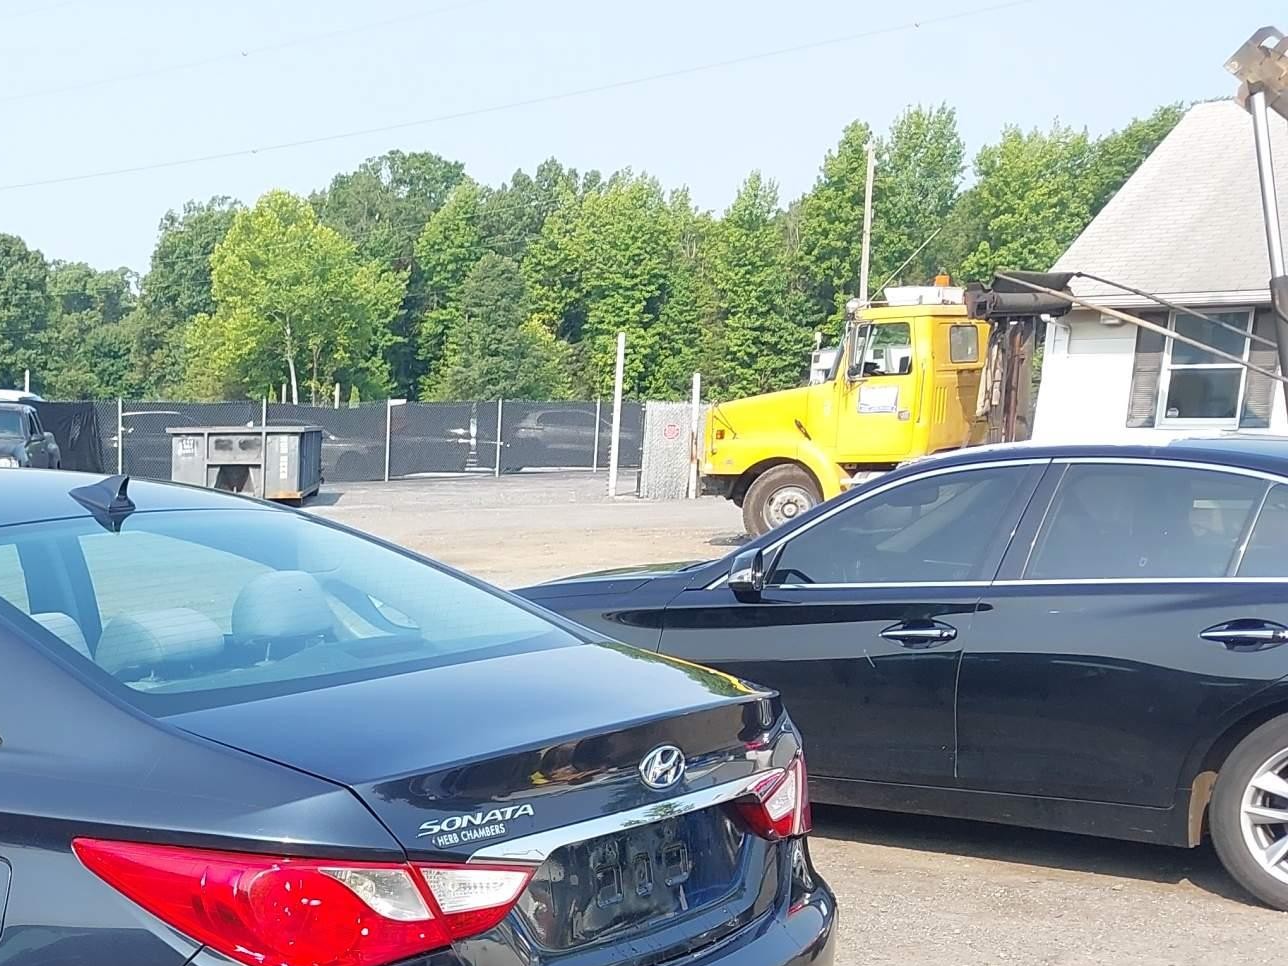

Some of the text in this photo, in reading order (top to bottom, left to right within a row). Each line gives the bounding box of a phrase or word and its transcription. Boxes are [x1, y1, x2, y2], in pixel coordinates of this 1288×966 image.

[416, 803, 535, 838] SONATA
[436, 823, 507, 847] HERB CHAMBERS
